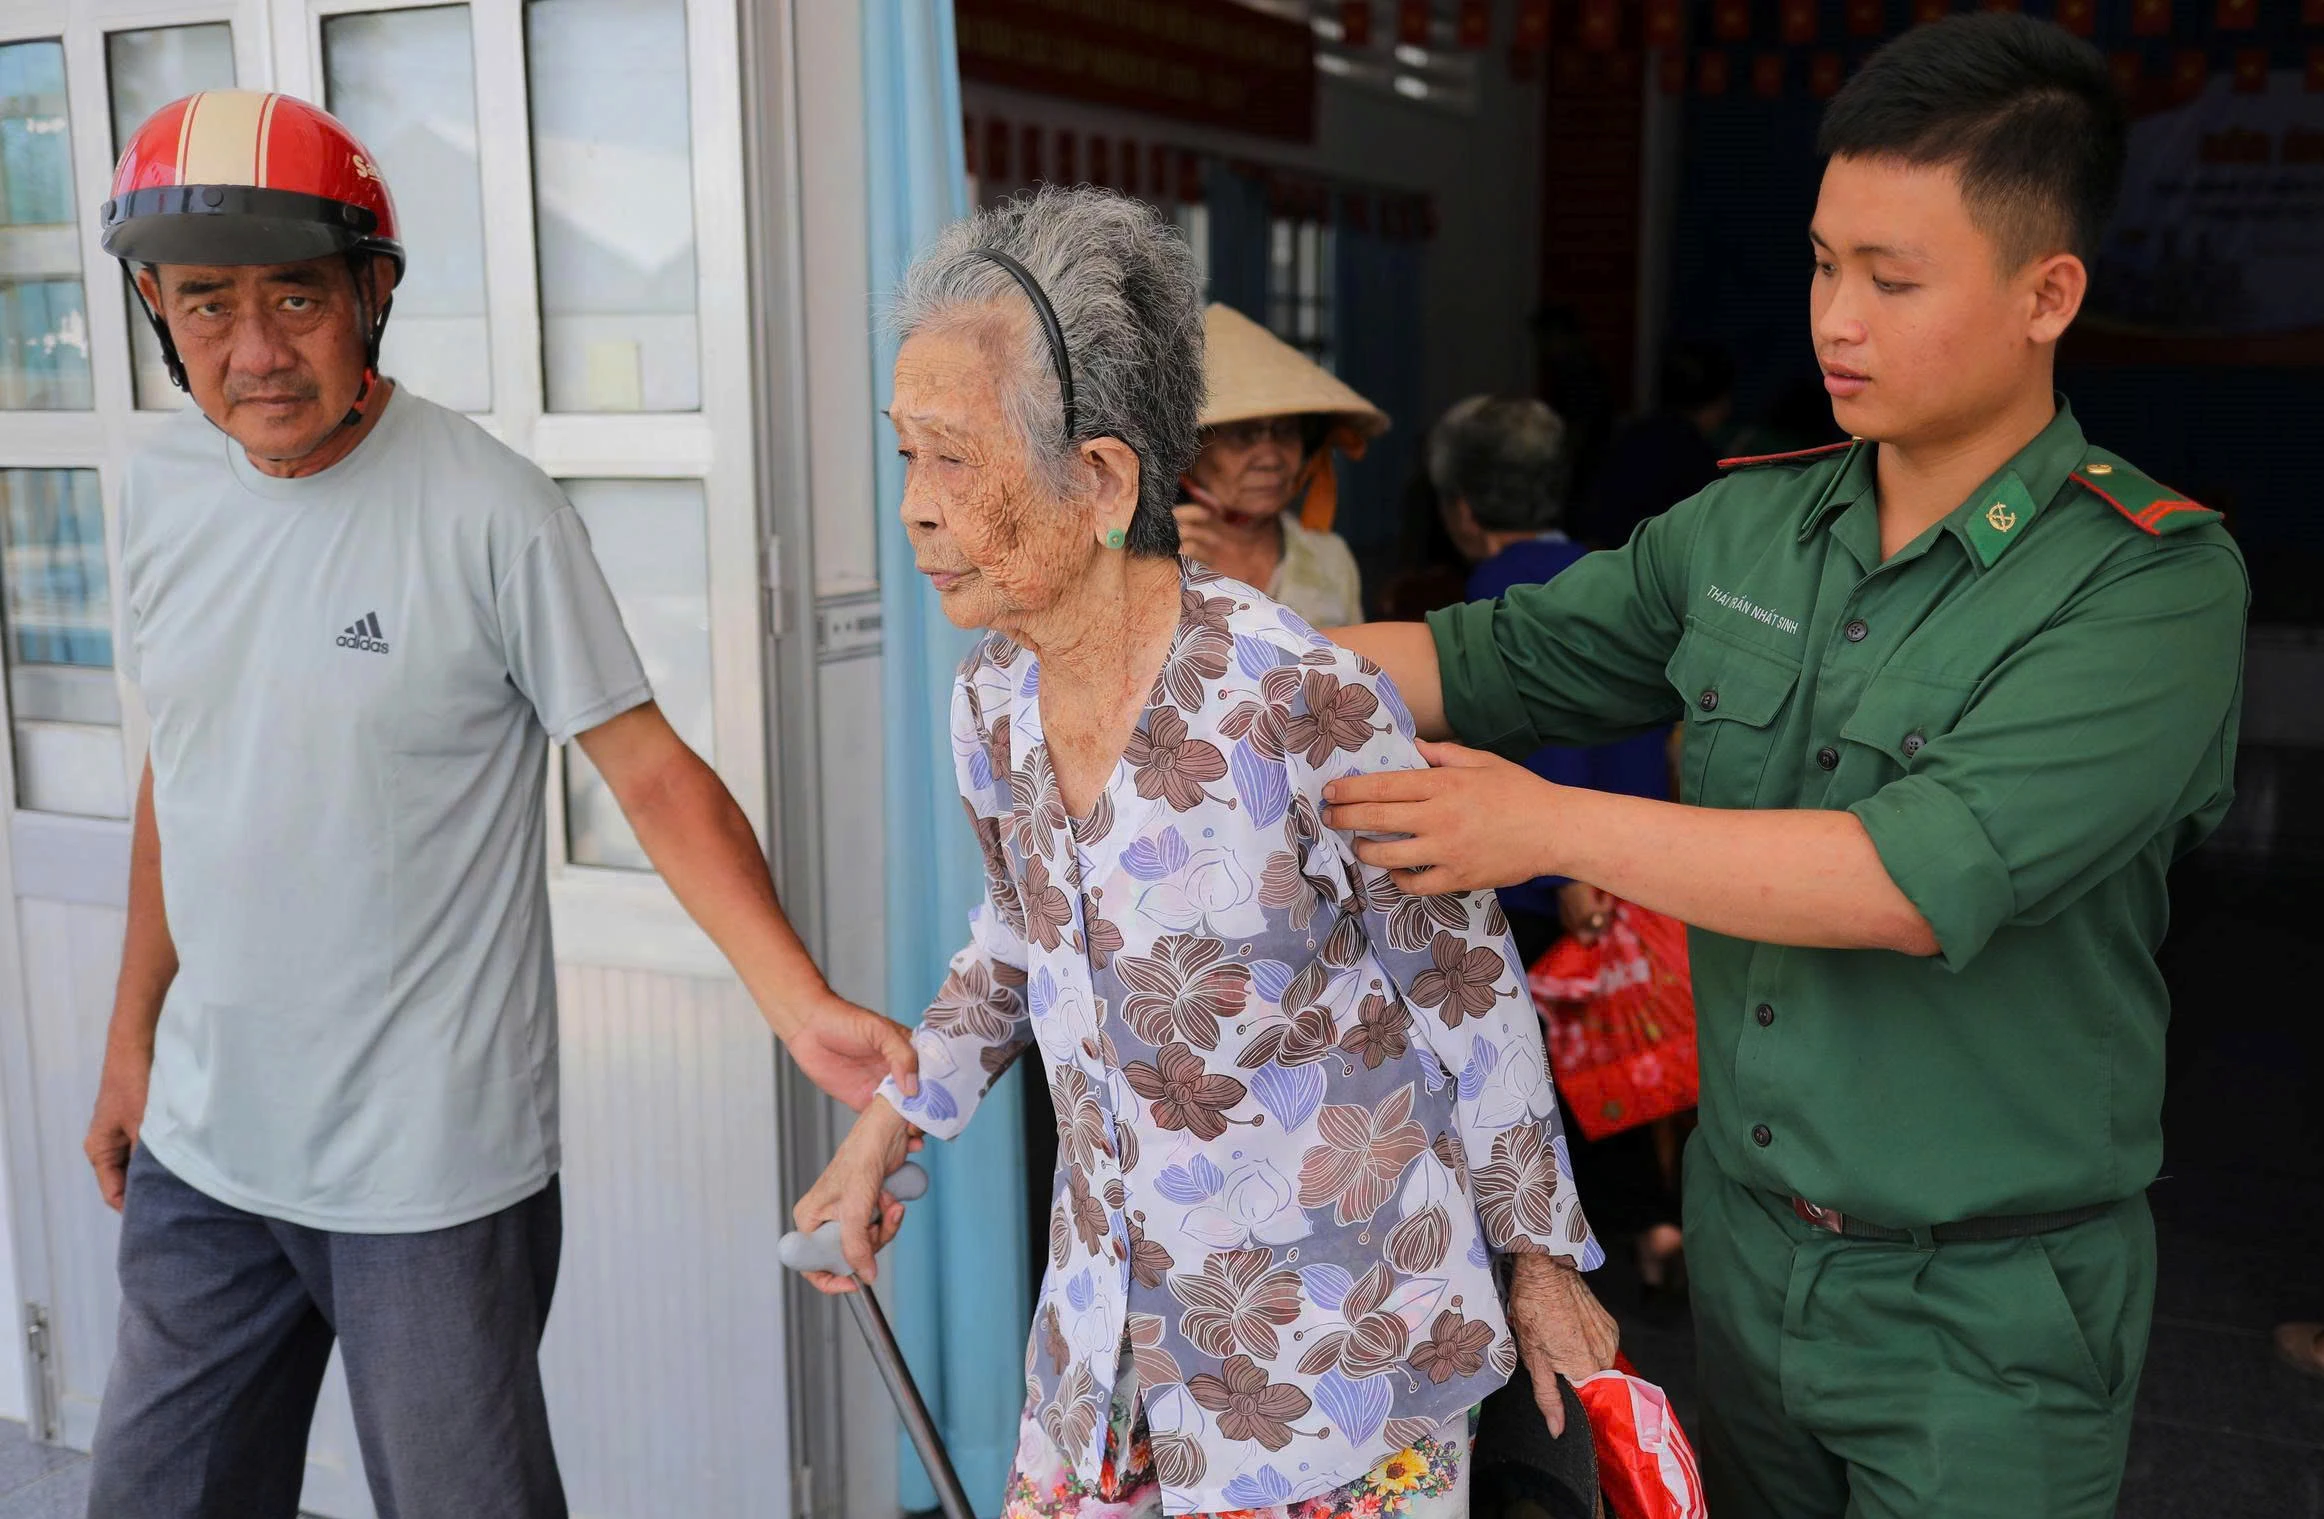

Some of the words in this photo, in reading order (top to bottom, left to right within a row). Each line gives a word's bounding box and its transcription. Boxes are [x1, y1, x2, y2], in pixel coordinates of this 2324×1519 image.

[1706, 584, 1732, 607] THÁI
[1776, 616, 1799, 635] SINH
[336, 634, 389, 654] adidas
